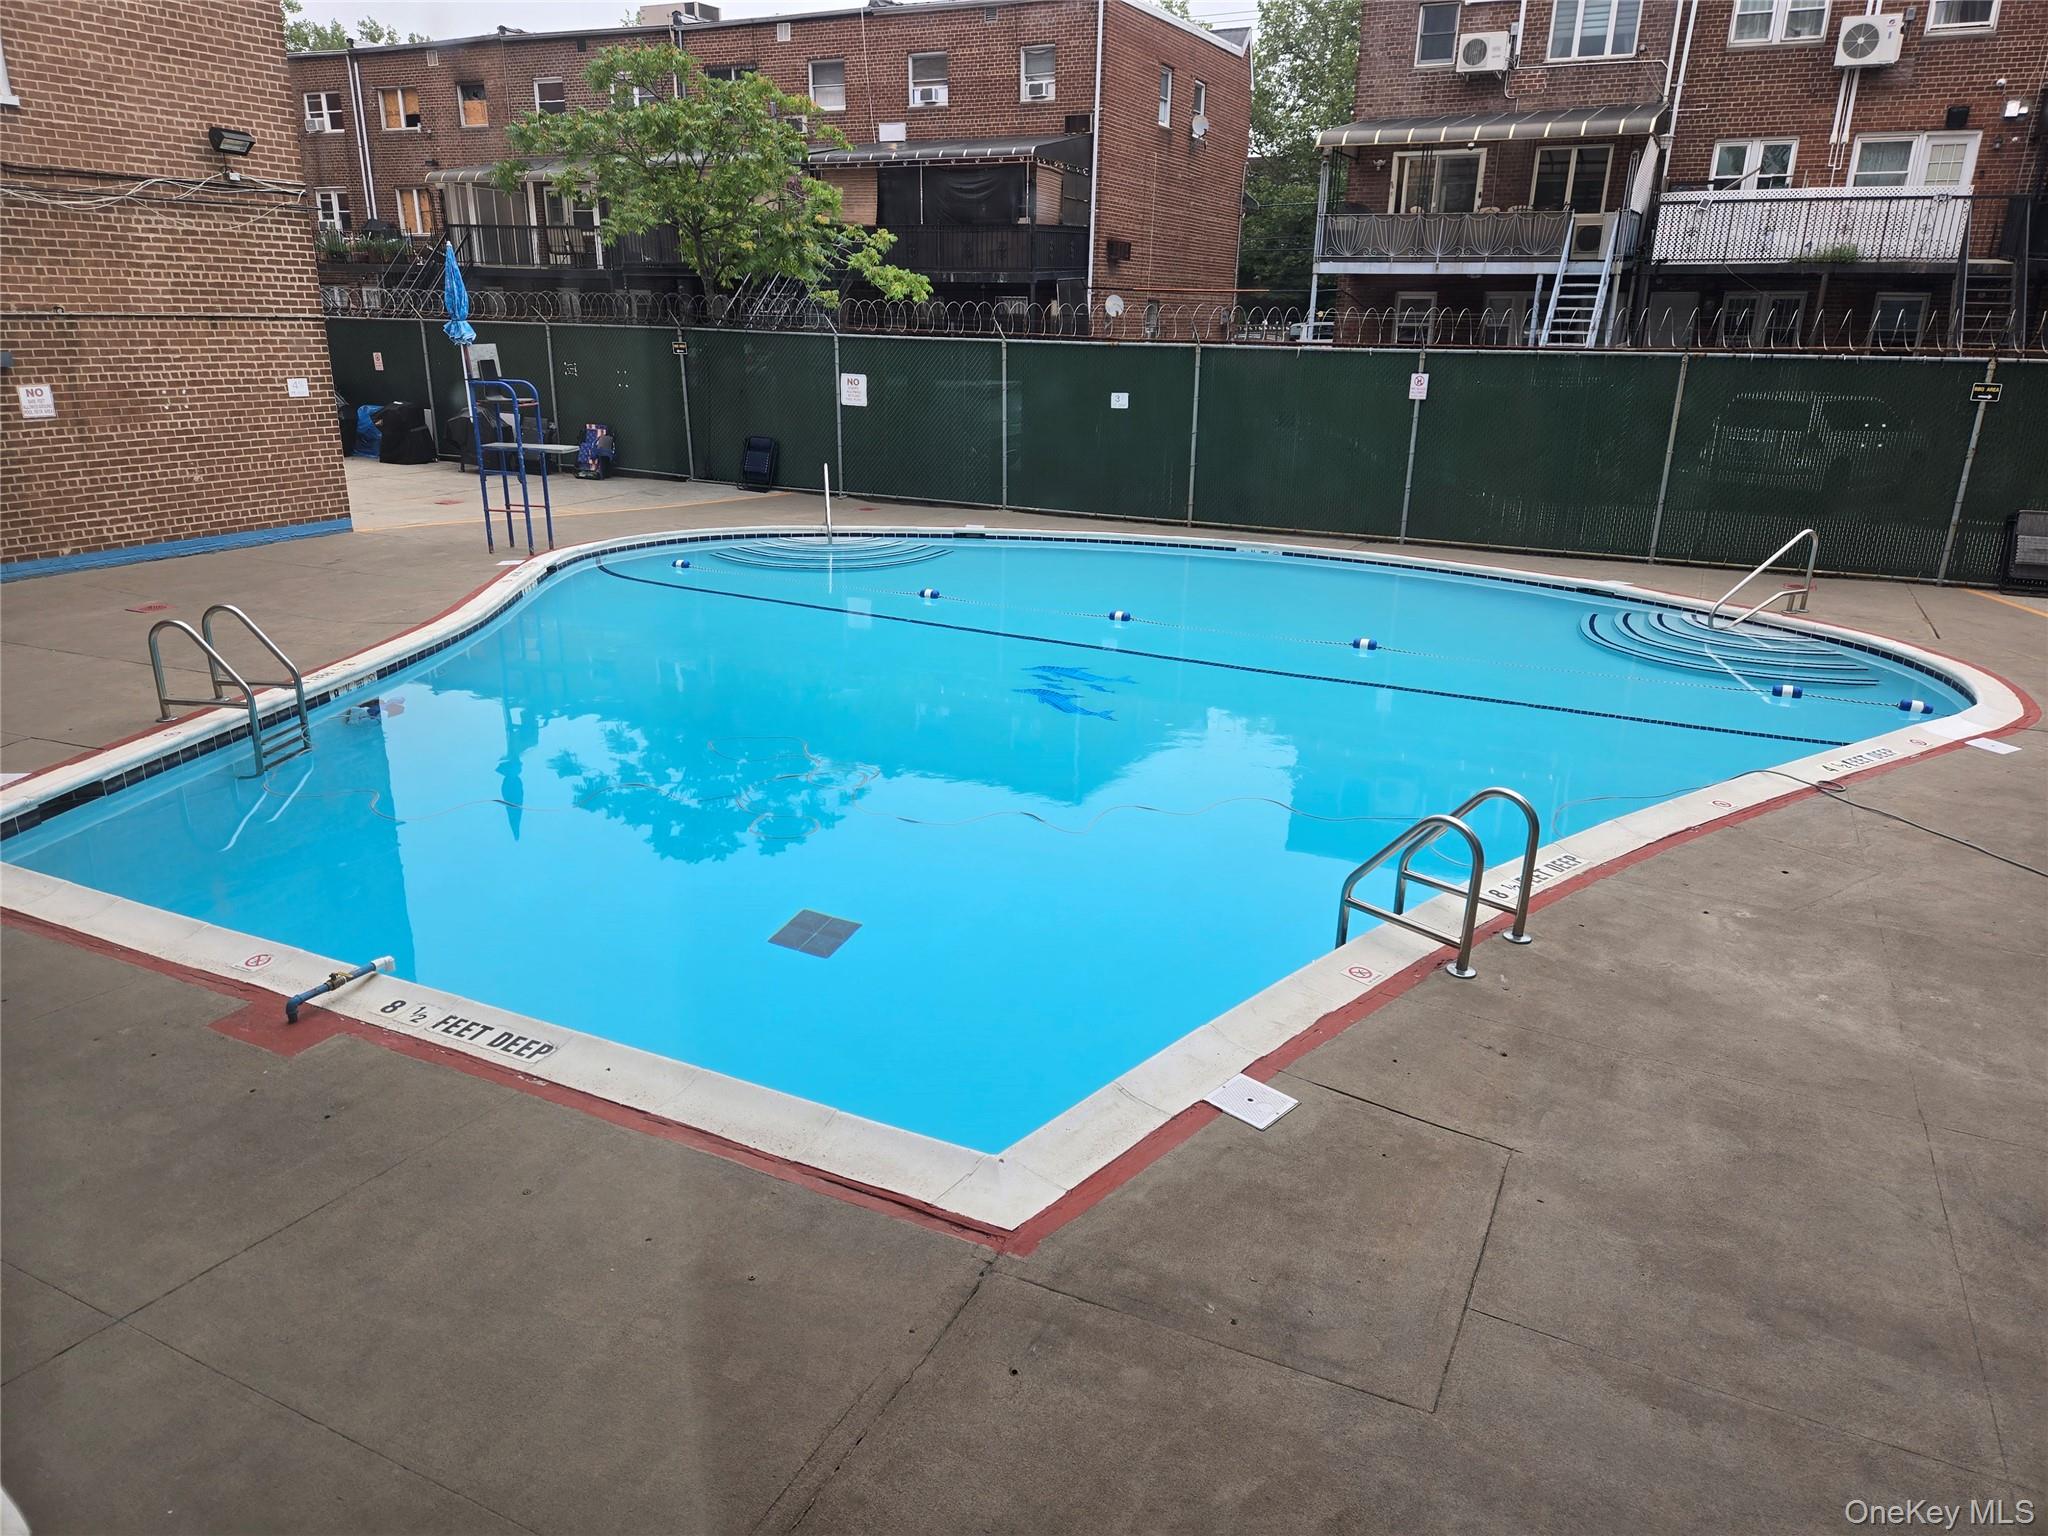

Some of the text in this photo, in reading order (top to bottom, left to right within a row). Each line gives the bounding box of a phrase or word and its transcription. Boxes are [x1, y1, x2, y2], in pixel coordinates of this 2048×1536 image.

[25, 388, 44, 397] NO
[847, 378, 860, 386] NO
[1488, 889, 1509, 899] 8
[1543, 854, 1582, 873] DEEP
[380, 1000, 407, 1014] 8
[431, 1014, 495, 1041] FEET
[486, 1031, 555, 1060] DEEP
